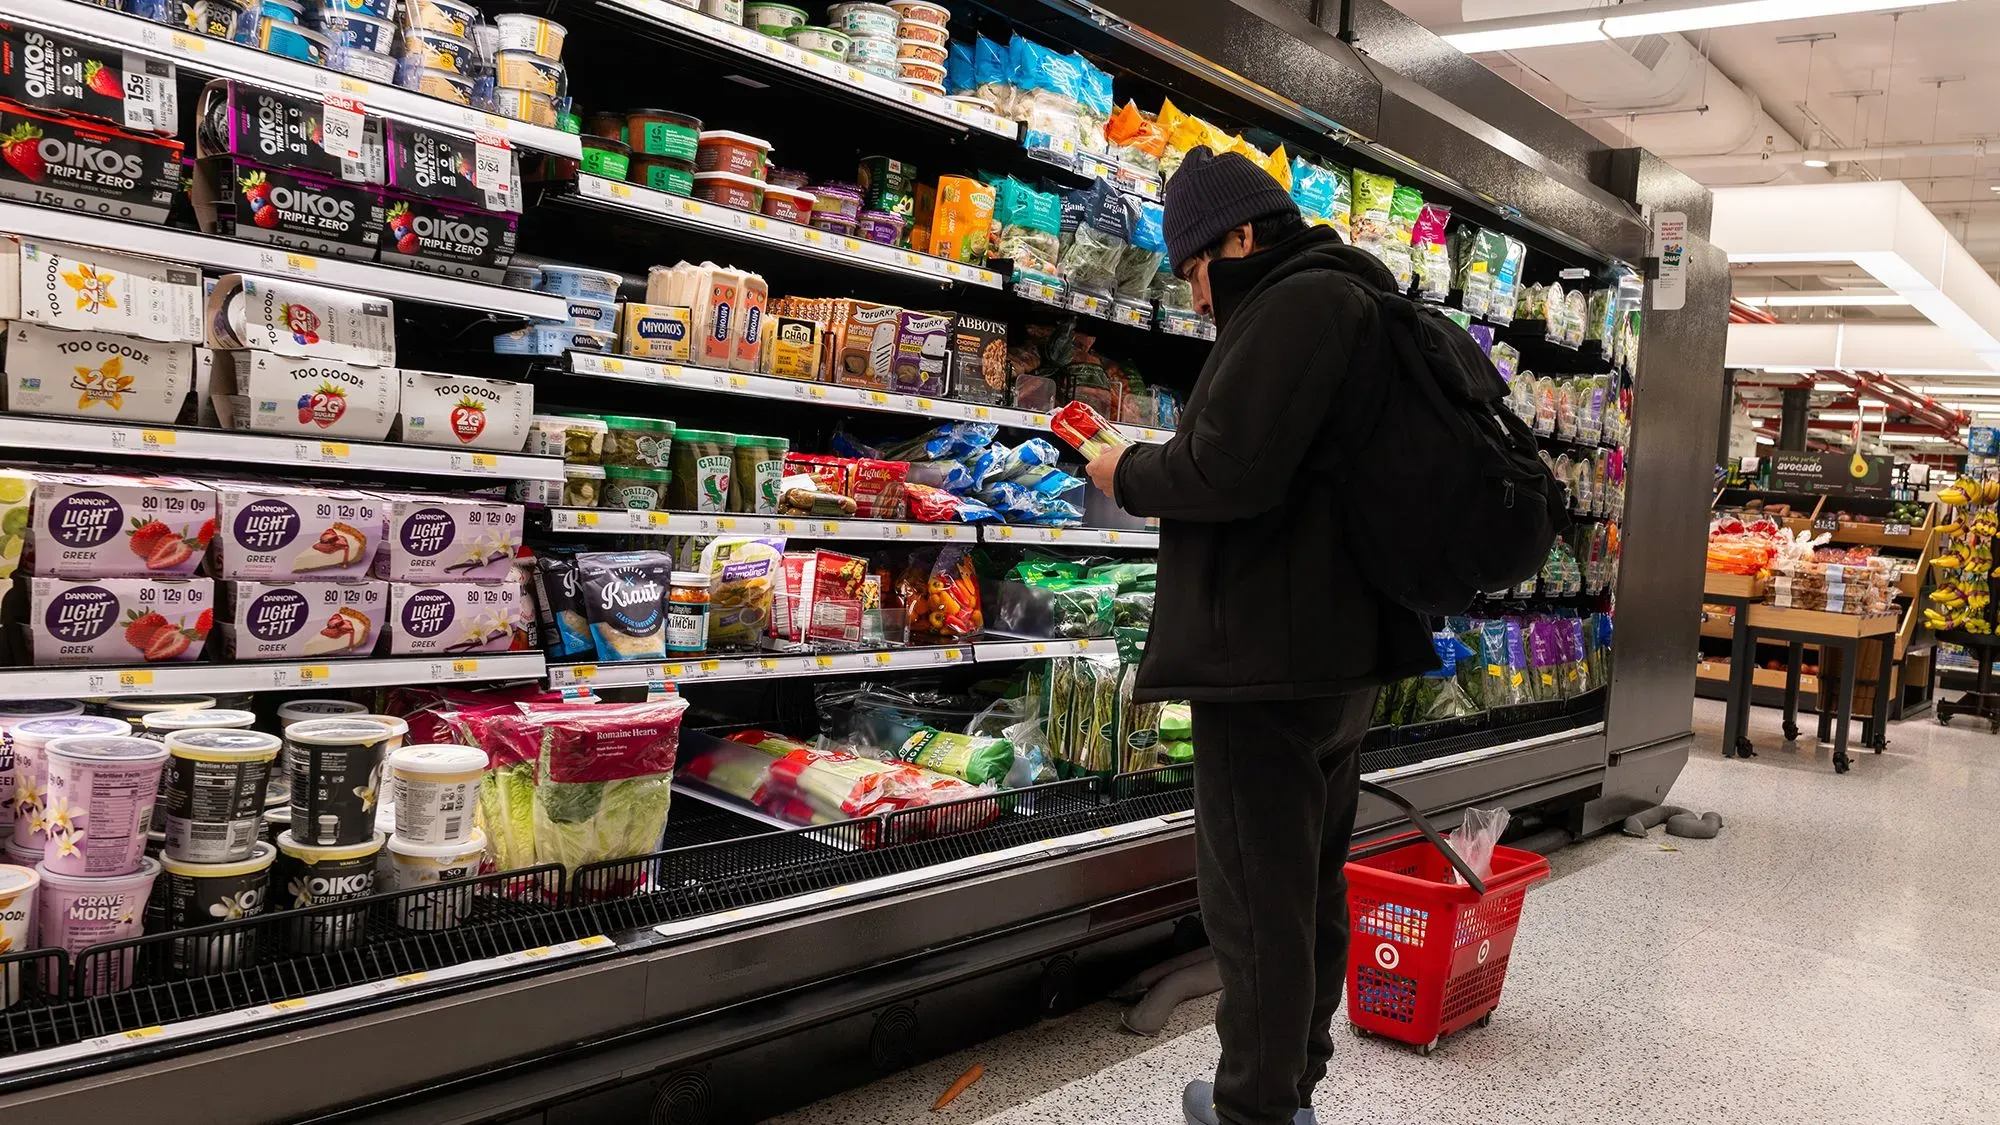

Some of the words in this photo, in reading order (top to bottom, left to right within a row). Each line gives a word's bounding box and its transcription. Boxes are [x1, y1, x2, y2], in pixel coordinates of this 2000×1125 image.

[45, 41, 54, 63] ZERO
[24, 32, 46, 98] OIKOS
[45, 64, 56, 95] TRIPLE
[128, 74, 144, 101] 15g
[324, 92, 354, 110] Sale!
[276, 102, 284, 124] ZERO
[258, 95, 277, 156] OIKOS
[277, 124, 285, 152] TRIPLE
[427, 138, 435, 159] ZERO
[38, 138, 143, 179] OIKOS
[413, 132, 431, 188] OIKOS
[731, 155, 752, 167] salsa
[44, 163, 94, 182] TRIPLE
[95, 173, 135, 190] ZERO
[429, 159, 437, 185] TRIPLE
[34, 189, 64, 207] 15g
[270, 187, 355, 222] OIKOS
[277, 209, 315, 226] TRIPLE
[318, 217, 349, 232] ZERO
[776, 208, 797, 219] salsa
[412, 216, 489, 247] OIKOS
[418, 236, 453, 251] TRIPLE
[454, 243, 483, 256] ZERO
[1663, 255, 1680, 263] SNAP
[46, 257, 60, 290] GOOD
[50, 291, 62, 318] TOO
[264, 293, 273, 322] GOOD
[860, 308, 896, 319] TOFURKY
[642, 321, 682, 335] MIYOKO'S
[912, 319, 944, 329] TOFURKY
[957, 316, 1006, 335] ABBOT'S
[18, 330, 28, 339] 4
[266, 322, 278, 345] TOO
[784, 330, 808, 341] CHAO
[57, 341, 93, 354] TOO
[96, 341, 142, 361] GOOD
[258, 359, 265, 367] 4
[85, 369, 118, 391] 2G
[290, 367, 318, 381] TOO
[321, 368, 359, 385] GOOD
[407, 377, 414, 385] 4
[434, 385, 460, 397] TOO
[462, 385, 495, 401] GOOD
[313, 394, 340, 412] 2G
[314, 411, 336, 419] SUGAR
[456, 408, 480, 426] 2G
[858, 467, 891, 481] Lightlife
[1777, 462, 1822, 473] avocado
[623, 487, 656, 497] GRILLO'S
[68, 496, 105, 506] DANNON
[142, 496, 158, 509] 80
[165, 497, 184, 512] 12g
[190, 500, 205, 512] 0g
[250, 504, 284, 513] DANNON
[631, 501, 649, 509] Chips
[61, 508, 113, 528] LIGHT
[316, 504, 331, 516] 80
[337, 505, 355, 518] 12g
[360, 506, 373, 519] 0g
[469, 511, 481, 522] 80
[486, 511, 500, 523] 12g
[505, 513, 516, 523] 0g
[245, 514, 292, 533] LIGHT
[410, 522, 448, 541] LIGHT
[75, 526, 107, 543] FIT
[257, 531, 286, 547] FIT
[420, 536, 443, 552] FIT
[62, 551, 97, 560] GREEK
[246, 554, 277, 563] GREEK
[410, 559, 436, 567] GREEK
[726, 568, 766, 584] Dumplings
[65, 592, 103, 600] DANNON
[139, 588, 155, 601] 80
[163, 588, 181, 602] 12g
[188, 589, 202, 602] 0g
[325, 590, 338, 602] 80
[344, 590, 360, 602] 12g
[365, 590, 378, 603] 0g
[467, 591, 479, 602] 80
[484, 591, 498, 602] 12g
[501, 591, 513, 602] 0g
[601, 580, 661, 610] Kraut
[58, 602, 109, 623] LIGHT
[257, 603, 300, 624] LIGHT
[411, 602, 449, 622] LIGHT
[72, 619, 103, 637] FIT
[268, 619, 295, 636] FIT
[420, 617, 443, 634] FIT
[668, 617, 696, 630] KIMCHI
[60, 645, 94, 654] GREEK
[258, 643, 287, 651] GREEK
[411, 640, 436, 648] GREEK
[89, 676, 104, 687] 3.77
[120, 675, 134, 684] 4.99
[301, 671, 313, 679] 4.99
[596, 730, 631, 740] Romaine
[632, 728, 657, 737] Hearts
[310, 869, 376, 896] OIKOS
[78, 894, 125, 907] CRAVE
[69, 905, 120, 921] MORE
